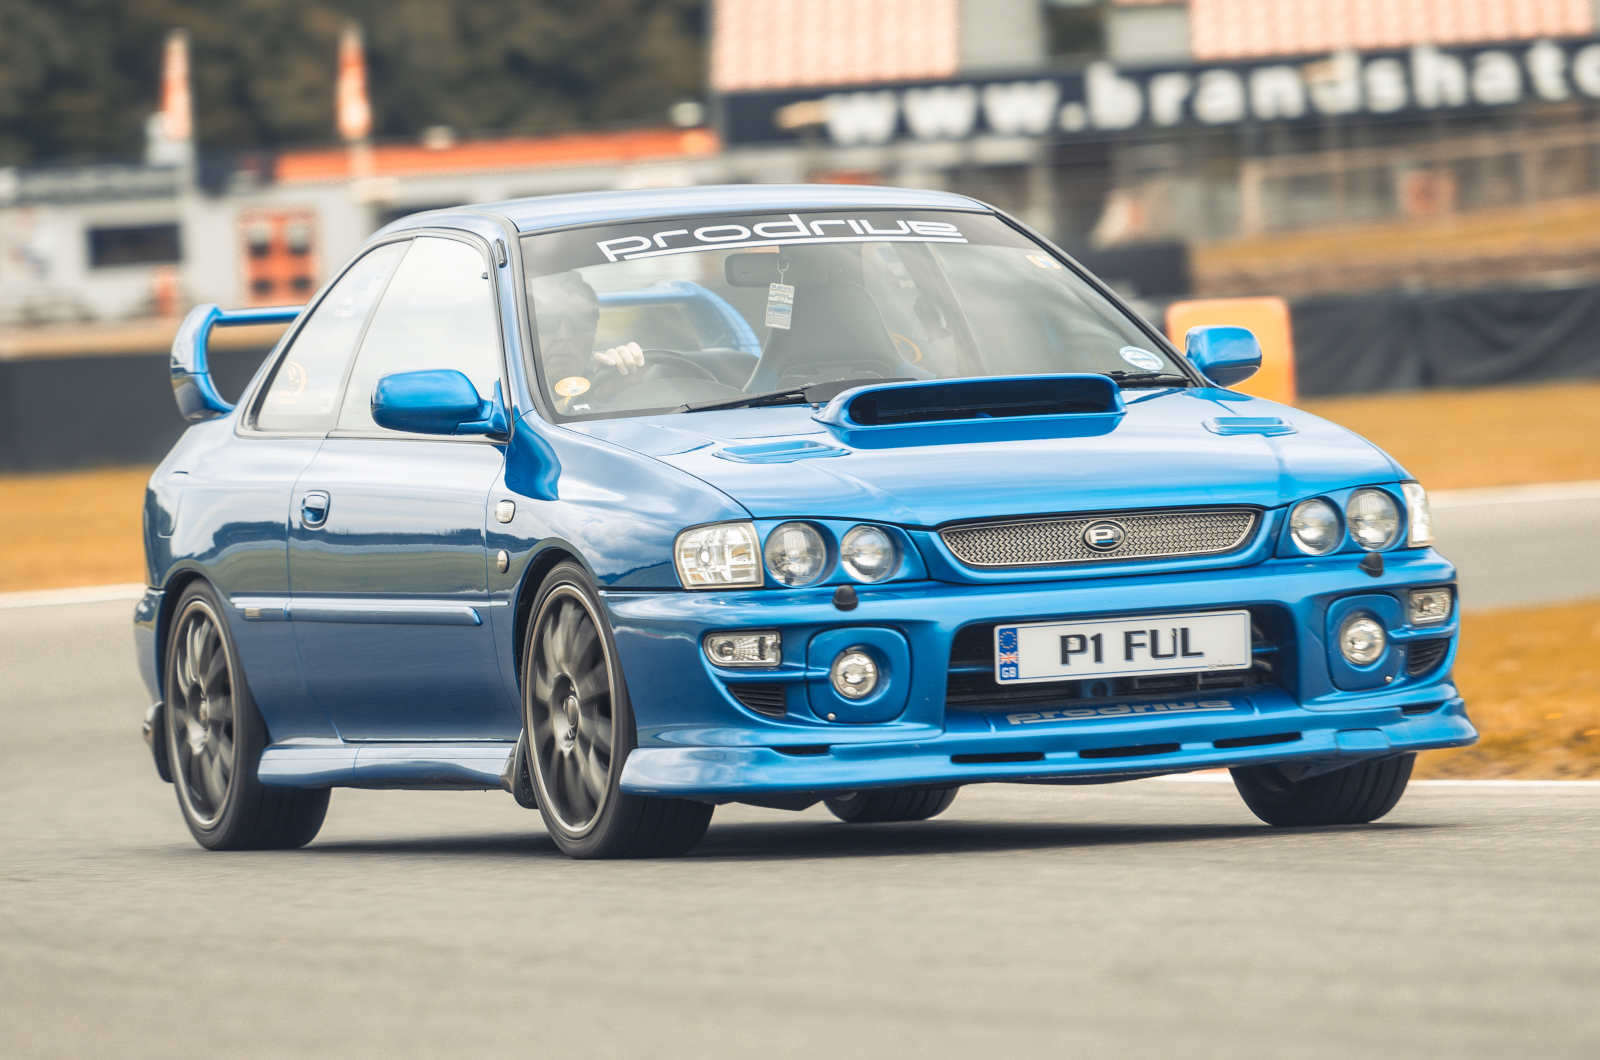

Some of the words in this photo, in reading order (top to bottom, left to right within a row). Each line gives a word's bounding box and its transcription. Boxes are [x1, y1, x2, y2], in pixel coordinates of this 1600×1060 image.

[596, 213, 964, 263] prodrive
[1059, 632, 1104, 667] P1
[1123, 627, 1205, 662] FUL
[1001, 666, 1017, 678] GB
[1005, 700, 1234, 726] prodrive
